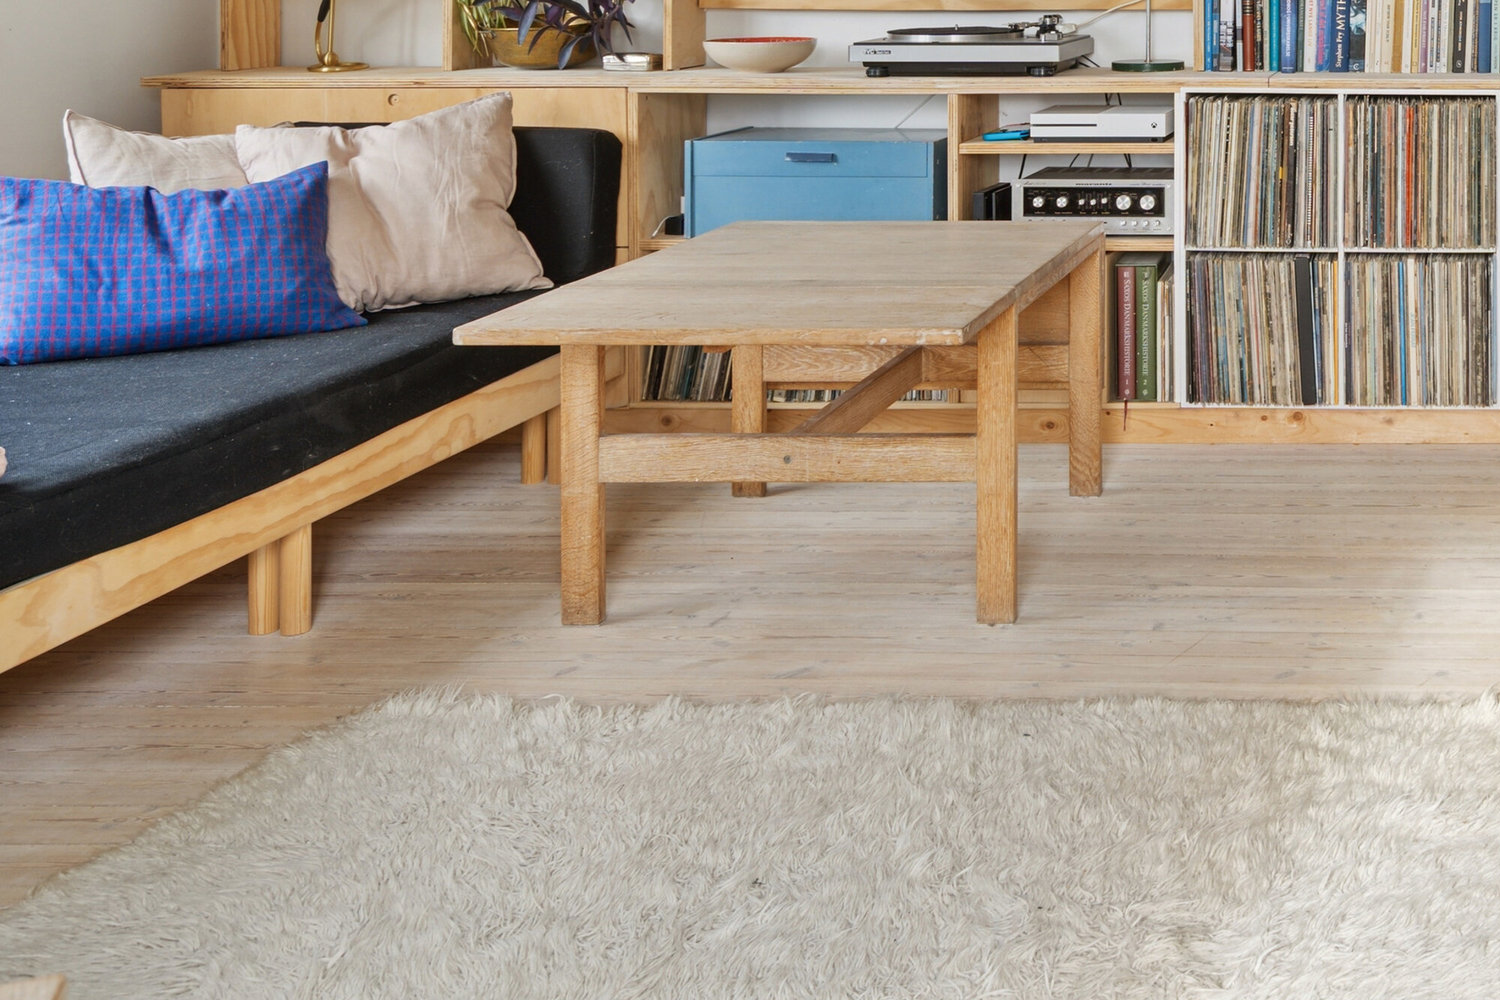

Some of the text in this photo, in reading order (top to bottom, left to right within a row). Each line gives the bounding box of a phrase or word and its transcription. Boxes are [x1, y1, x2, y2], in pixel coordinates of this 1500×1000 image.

[1334, 44, 1344, 68] Stephen
[1336, 32, 1345, 43] Fry
[1122, 279, 1131, 376] SAXOS DANMARKSHISTORIE
[1140, 279, 1150, 376] SAXOS DANMARKSHISTORIE
